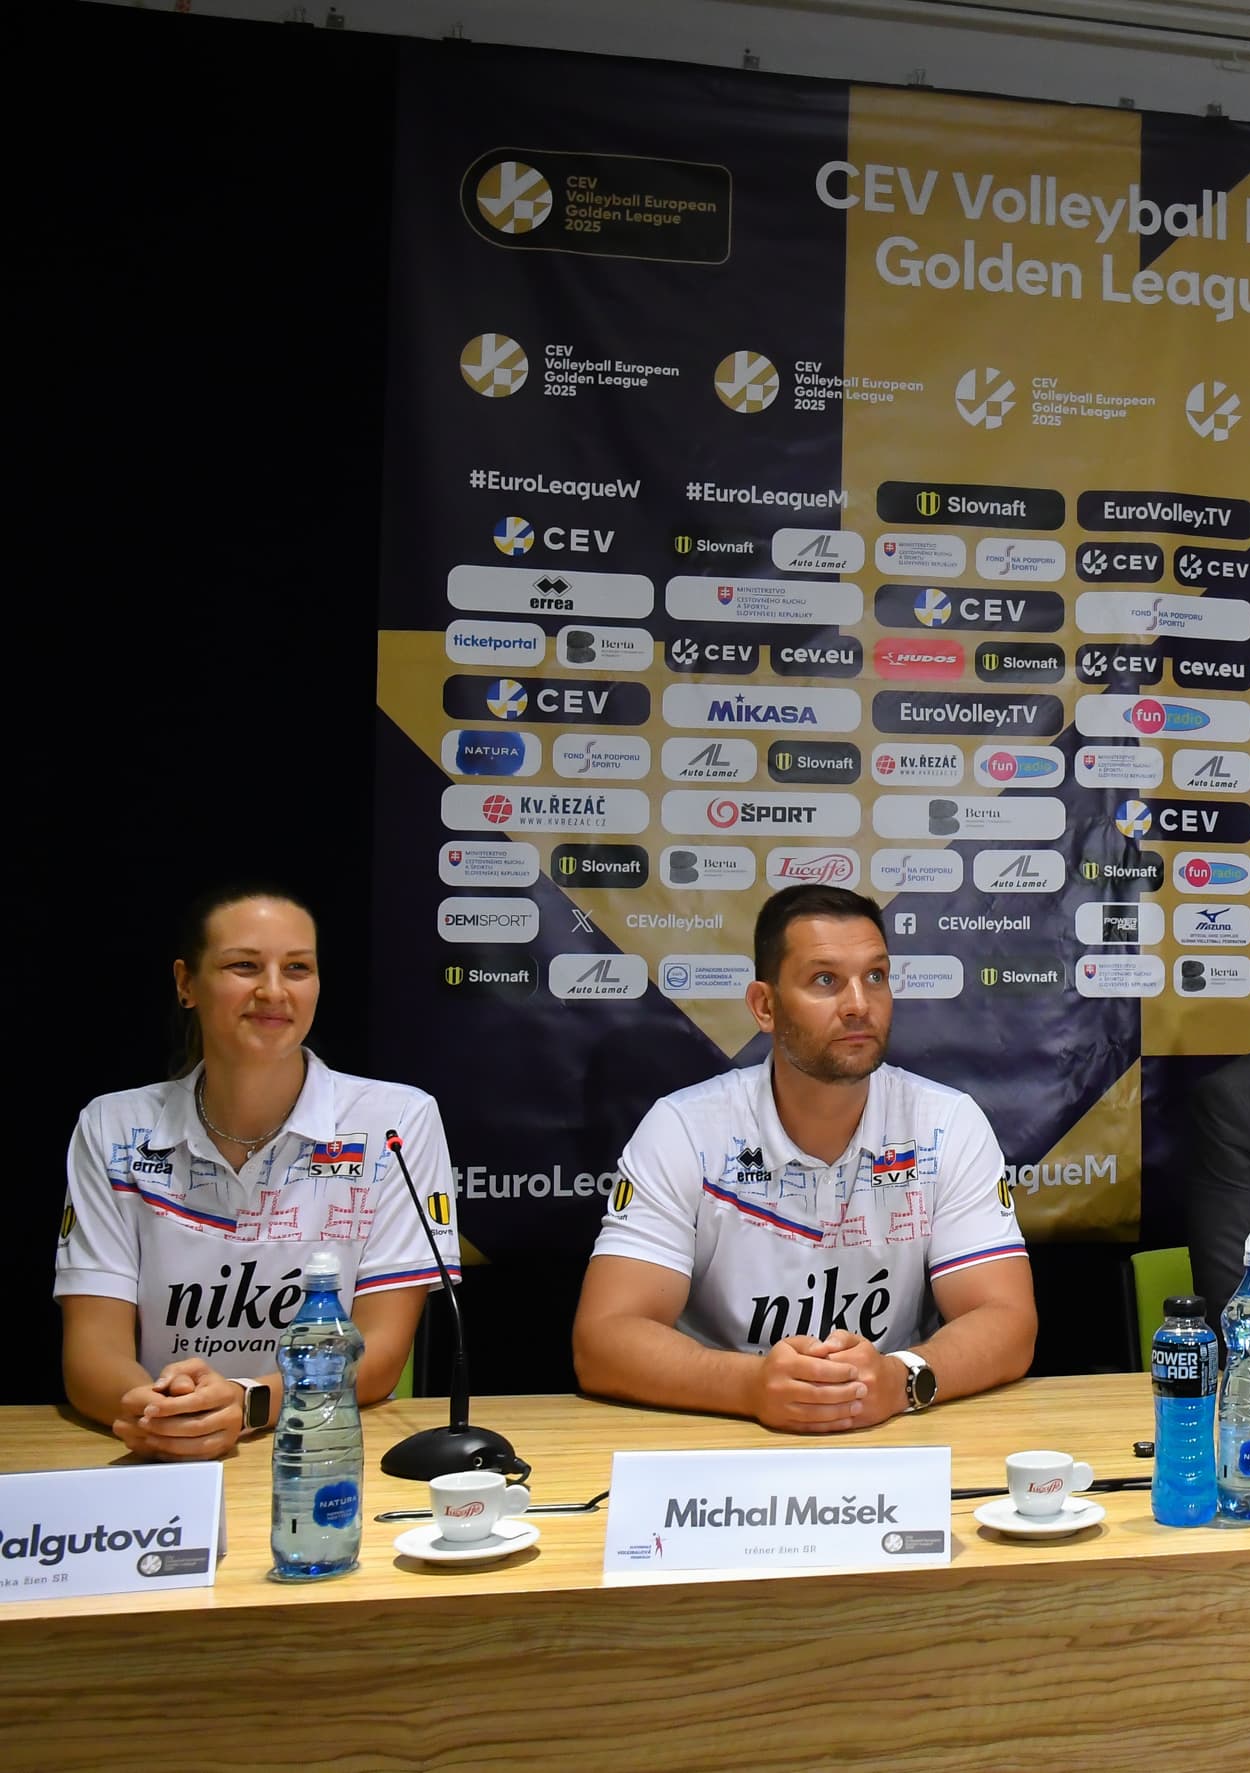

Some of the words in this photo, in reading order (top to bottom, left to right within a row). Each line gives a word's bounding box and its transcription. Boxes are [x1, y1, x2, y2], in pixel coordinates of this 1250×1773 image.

[566, 176, 598, 189] CEV
[566, 190, 640, 207] Volleyball
[645, 195, 716, 212] European
[815, 160, 938, 216] CEV
[953, 172, 1226, 244] Volleyball
[565, 205, 621, 220] Golden
[625, 209, 681, 226] League
[565, 219, 601, 232] 2025
[875, 235, 1082, 299] Golden
[545, 345, 573, 356] CEV
[544, 358, 611, 373] Volleyball
[615, 361, 680, 377] European
[794, 360, 822, 373] CEV
[544, 371, 594, 385] Golden
[598, 373, 648, 389] League
[794, 373, 859, 388] Volleyball
[862, 377, 924, 392] European
[543, 384, 577, 397] 2025
[794, 386, 843, 399] Golden
[846, 389, 894, 404] League
[794, 399, 826, 411] 2025
[469, 469, 641, 500] #EuroLeagueW
[686, 481, 848, 510] #EuroLeagueM
[947, 496, 1026, 517] Slovnaft
[1103, 501, 1232, 528] EuroVolley.TV
[543, 526, 615, 553] CEV
[696, 538, 754, 554] Slovnaft
[788, 558, 811, 569] Auto
[815, 558, 847, 569] Lamač
[959, 598, 1026, 622] CEV
[453, 634, 537, 652] ticketportal
[600, 639, 635, 651] Berta
[704, 645, 752, 662] CEV
[780, 645, 854, 665] cev.eu
[897, 653, 957, 664] HUDOS
[1179, 661, 1245, 679] cev.eu
[900, 703, 1037, 728] EuroVolley.TV
[1136, 709, 1162, 723] fun
[1167, 711, 1203, 725] radio
[464, 745, 520, 757] NATURA
[797, 756, 853, 771] Slovnaft
[988, 759, 1014, 772] fun
[679, 768, 703, 777] Auto
[706, 768, 738, 778] Lamač
[740, 803, 817, 824] ŠPORT
[1159, 808, 1219, 833] CEV
[582, 859, 641, 875] Slovnaft
[626, 913, 723, 931] CEVolleyball
[938, 916, 1030, 932] CEVolleyball
[1002, 970, 1058, 984] Slovnaft
[567, 985, 591, 994] Auto
[595, 984, 629, 995] Lamač
[873, 1167, 917, 1186] SVK
[166, 1260, 304, 1331] niké
[747, 1266, 890, 1343] niké
[173, 1336, 189, 1354] je
[194, 1335, 276, 1357] tipovan
[1151, 1352, 1197, 1366] POWER
[1167, 1366, 1198, 1380] ADE
[319, 1494, 360, 1509] NATURA
[664, 1496, 777, 1528] Michal
[784, 1494, 898, 1527] Mašek
[22, 1572, 48, 1587] žien
[51, 1573, 69, 1586] SR
